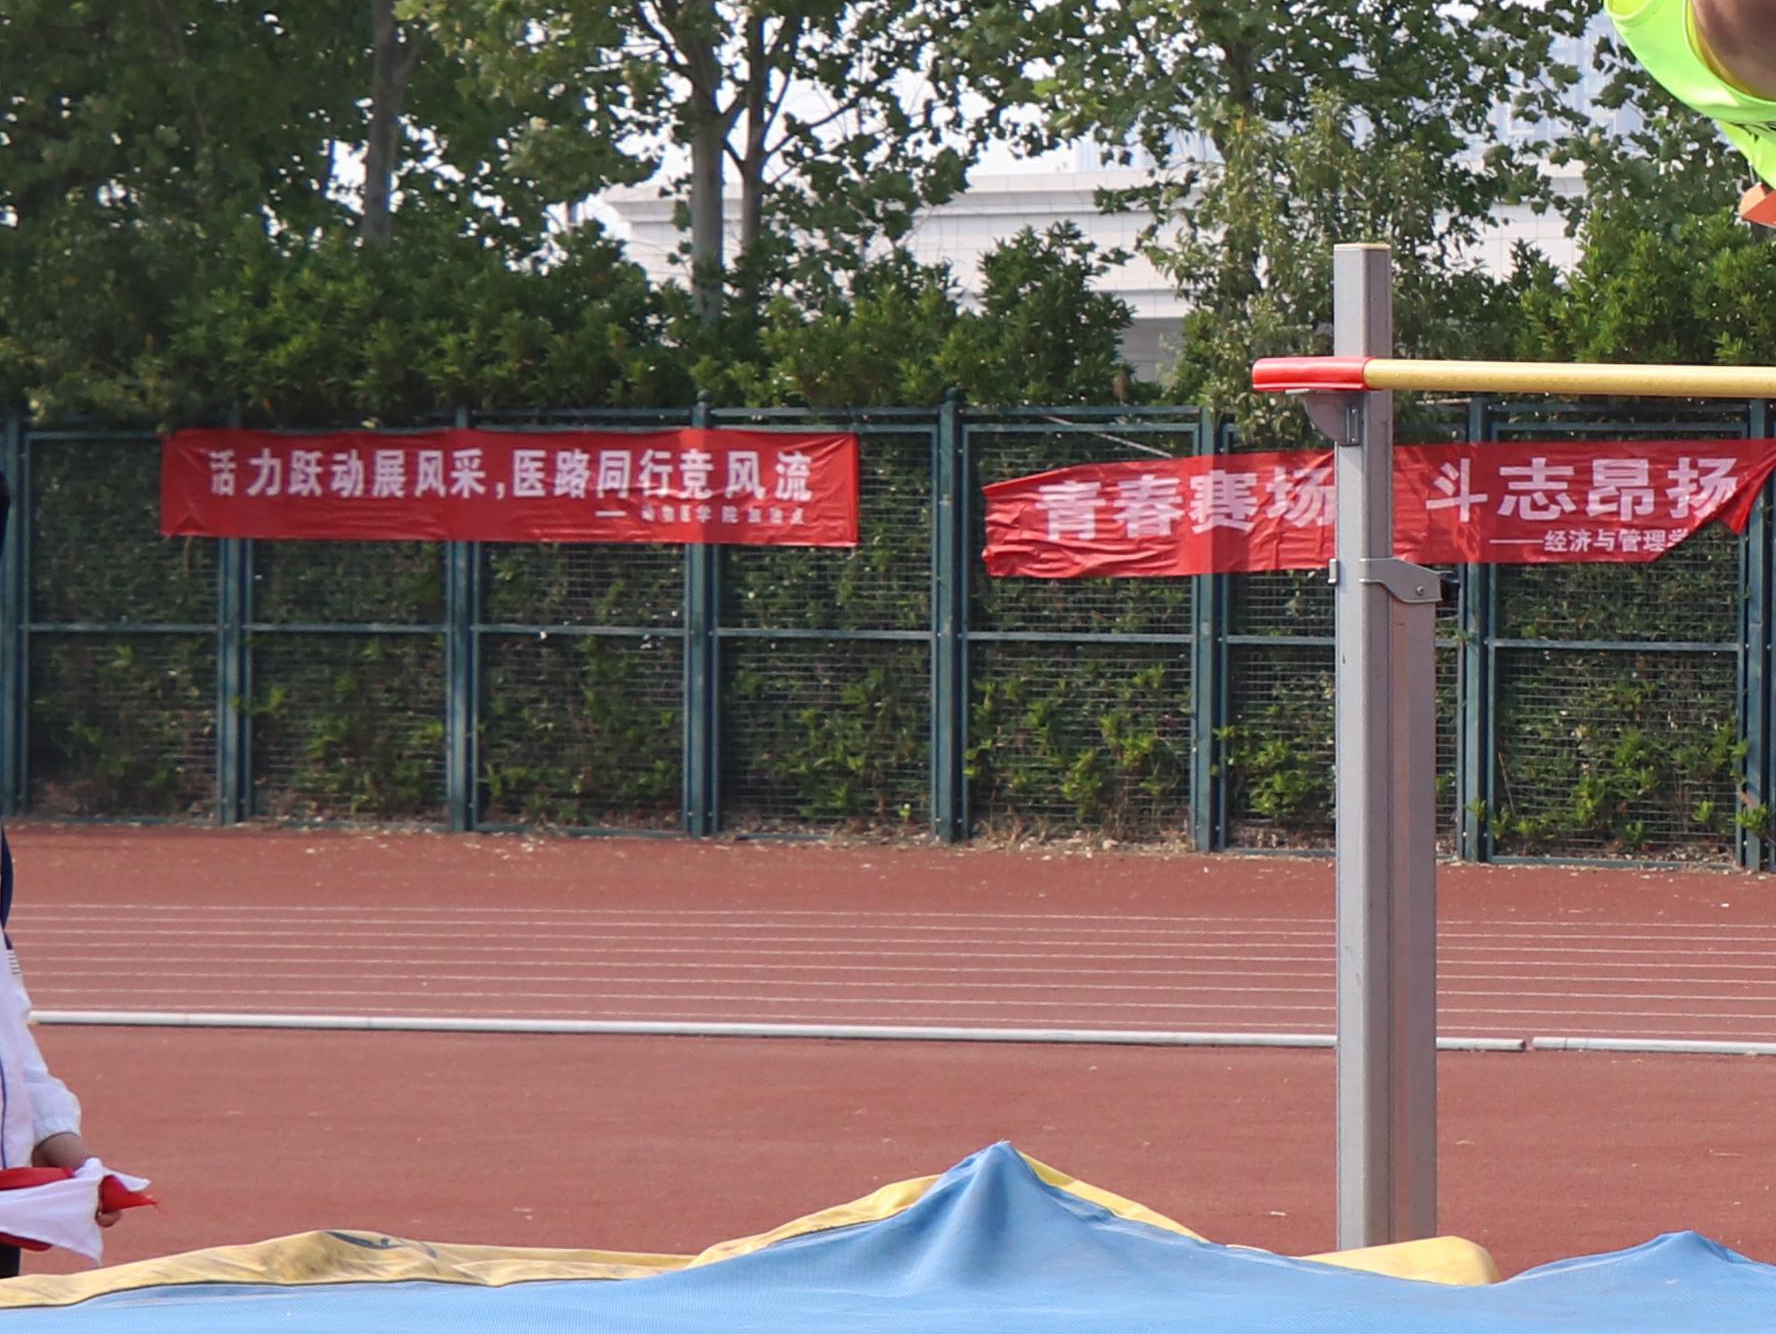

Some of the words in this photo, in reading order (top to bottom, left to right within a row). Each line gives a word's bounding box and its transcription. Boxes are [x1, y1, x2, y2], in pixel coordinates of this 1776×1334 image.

[1034, 466, 1337, 540] 青春赛场
[1426, 457, 1739, 524] 斗志昂扬
